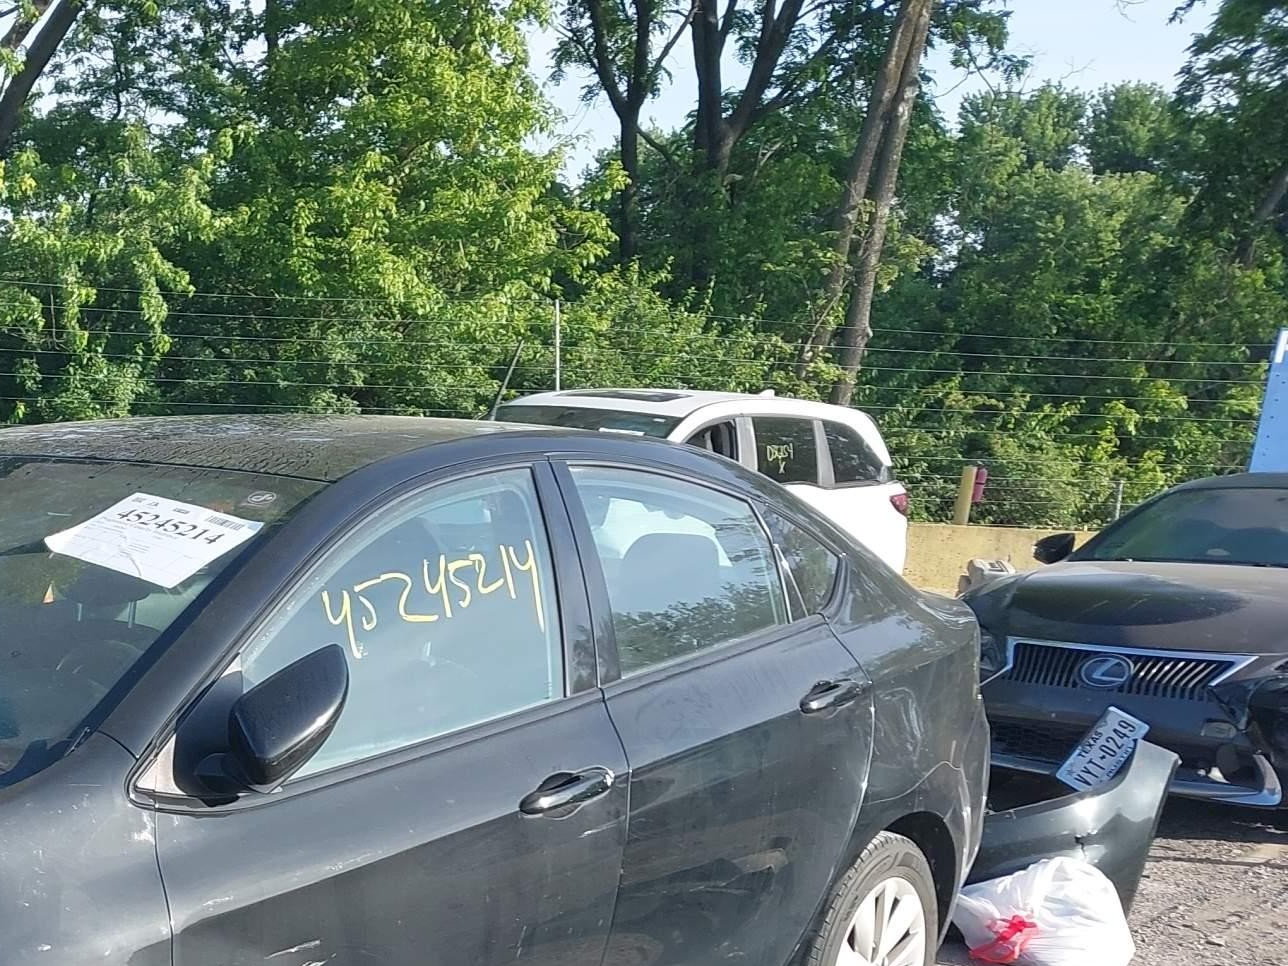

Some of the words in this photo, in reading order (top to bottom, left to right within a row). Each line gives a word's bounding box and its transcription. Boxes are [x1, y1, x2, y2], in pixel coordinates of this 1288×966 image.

[116, 507, 226, 545] 45245214
[321, 539, 546, 659] 45245214
[1079, 730, 1103, 758] TEXAS
